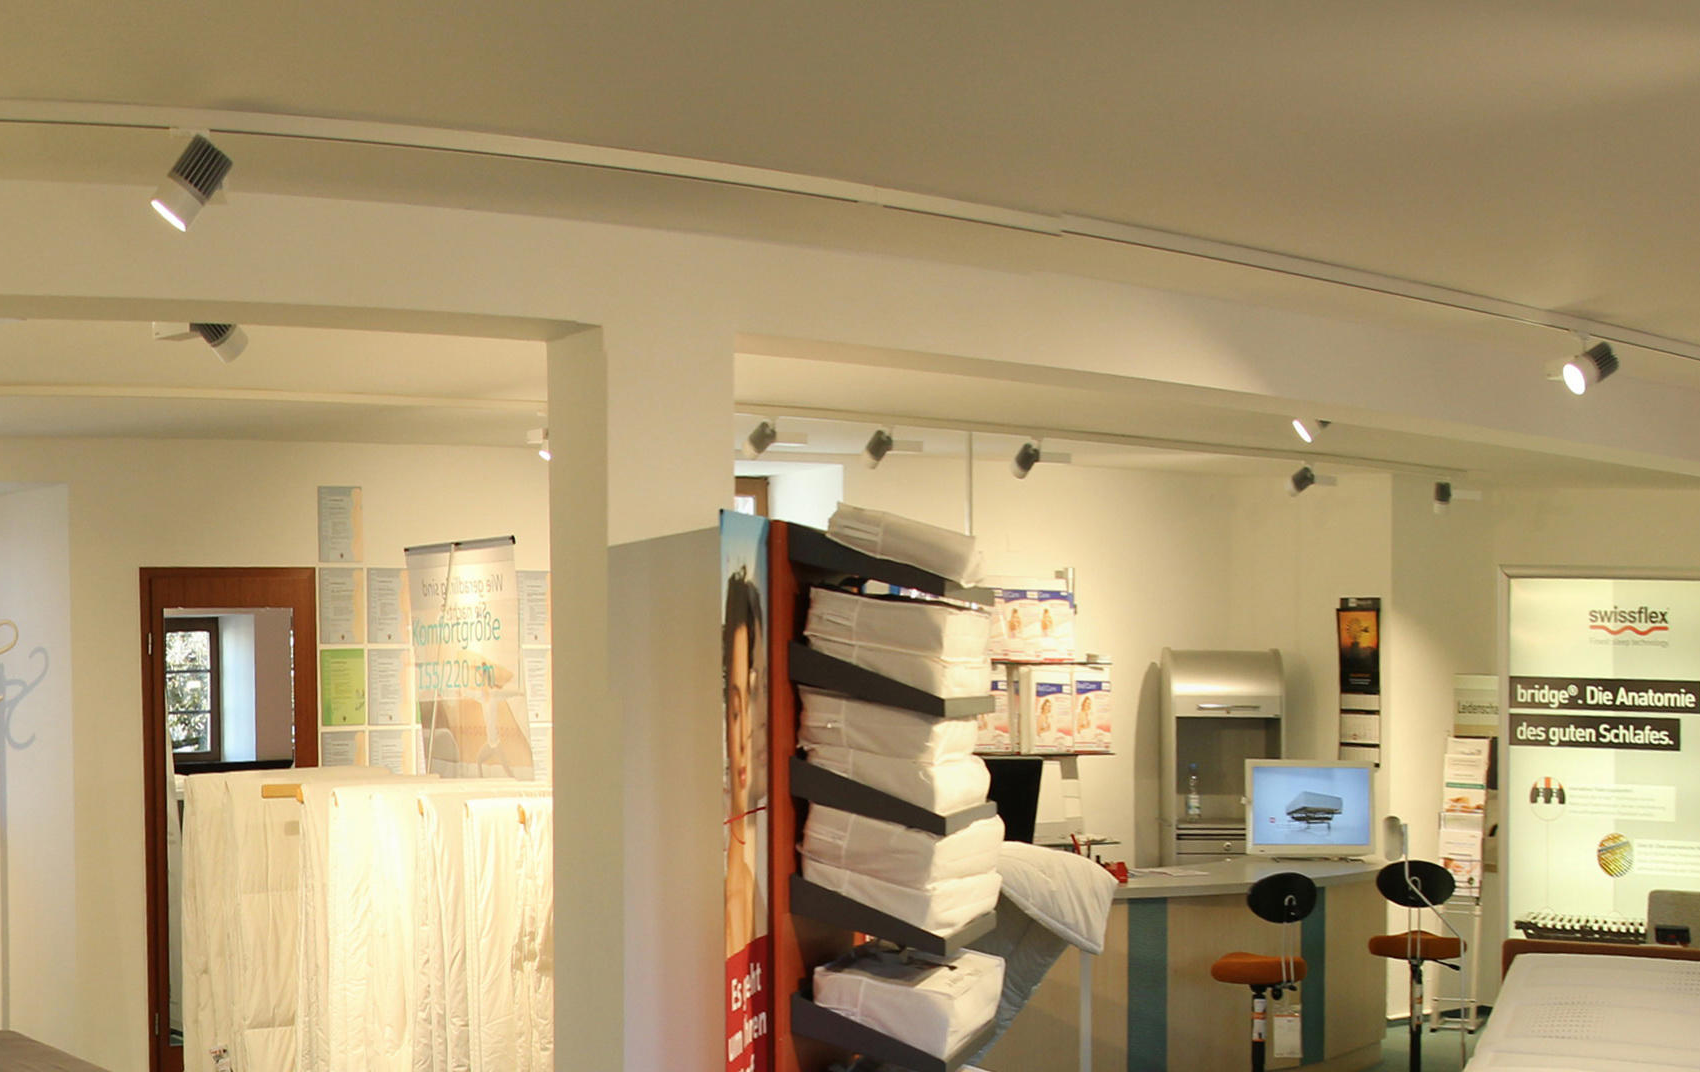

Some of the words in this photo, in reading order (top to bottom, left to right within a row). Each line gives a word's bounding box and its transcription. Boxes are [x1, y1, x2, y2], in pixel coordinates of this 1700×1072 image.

[1589, 605, 1670, 624] swissflex
[412, 611, 501, 650] Komfortgröße
[1586, 685, 1613, 705] Die
[1615, 687, 1696, 708] Anatomie
[1516, 722, 1546, 740] des
[1549, 724, 1596, 746] guten
[1598, 724, 1674, 745] Schlafes.
